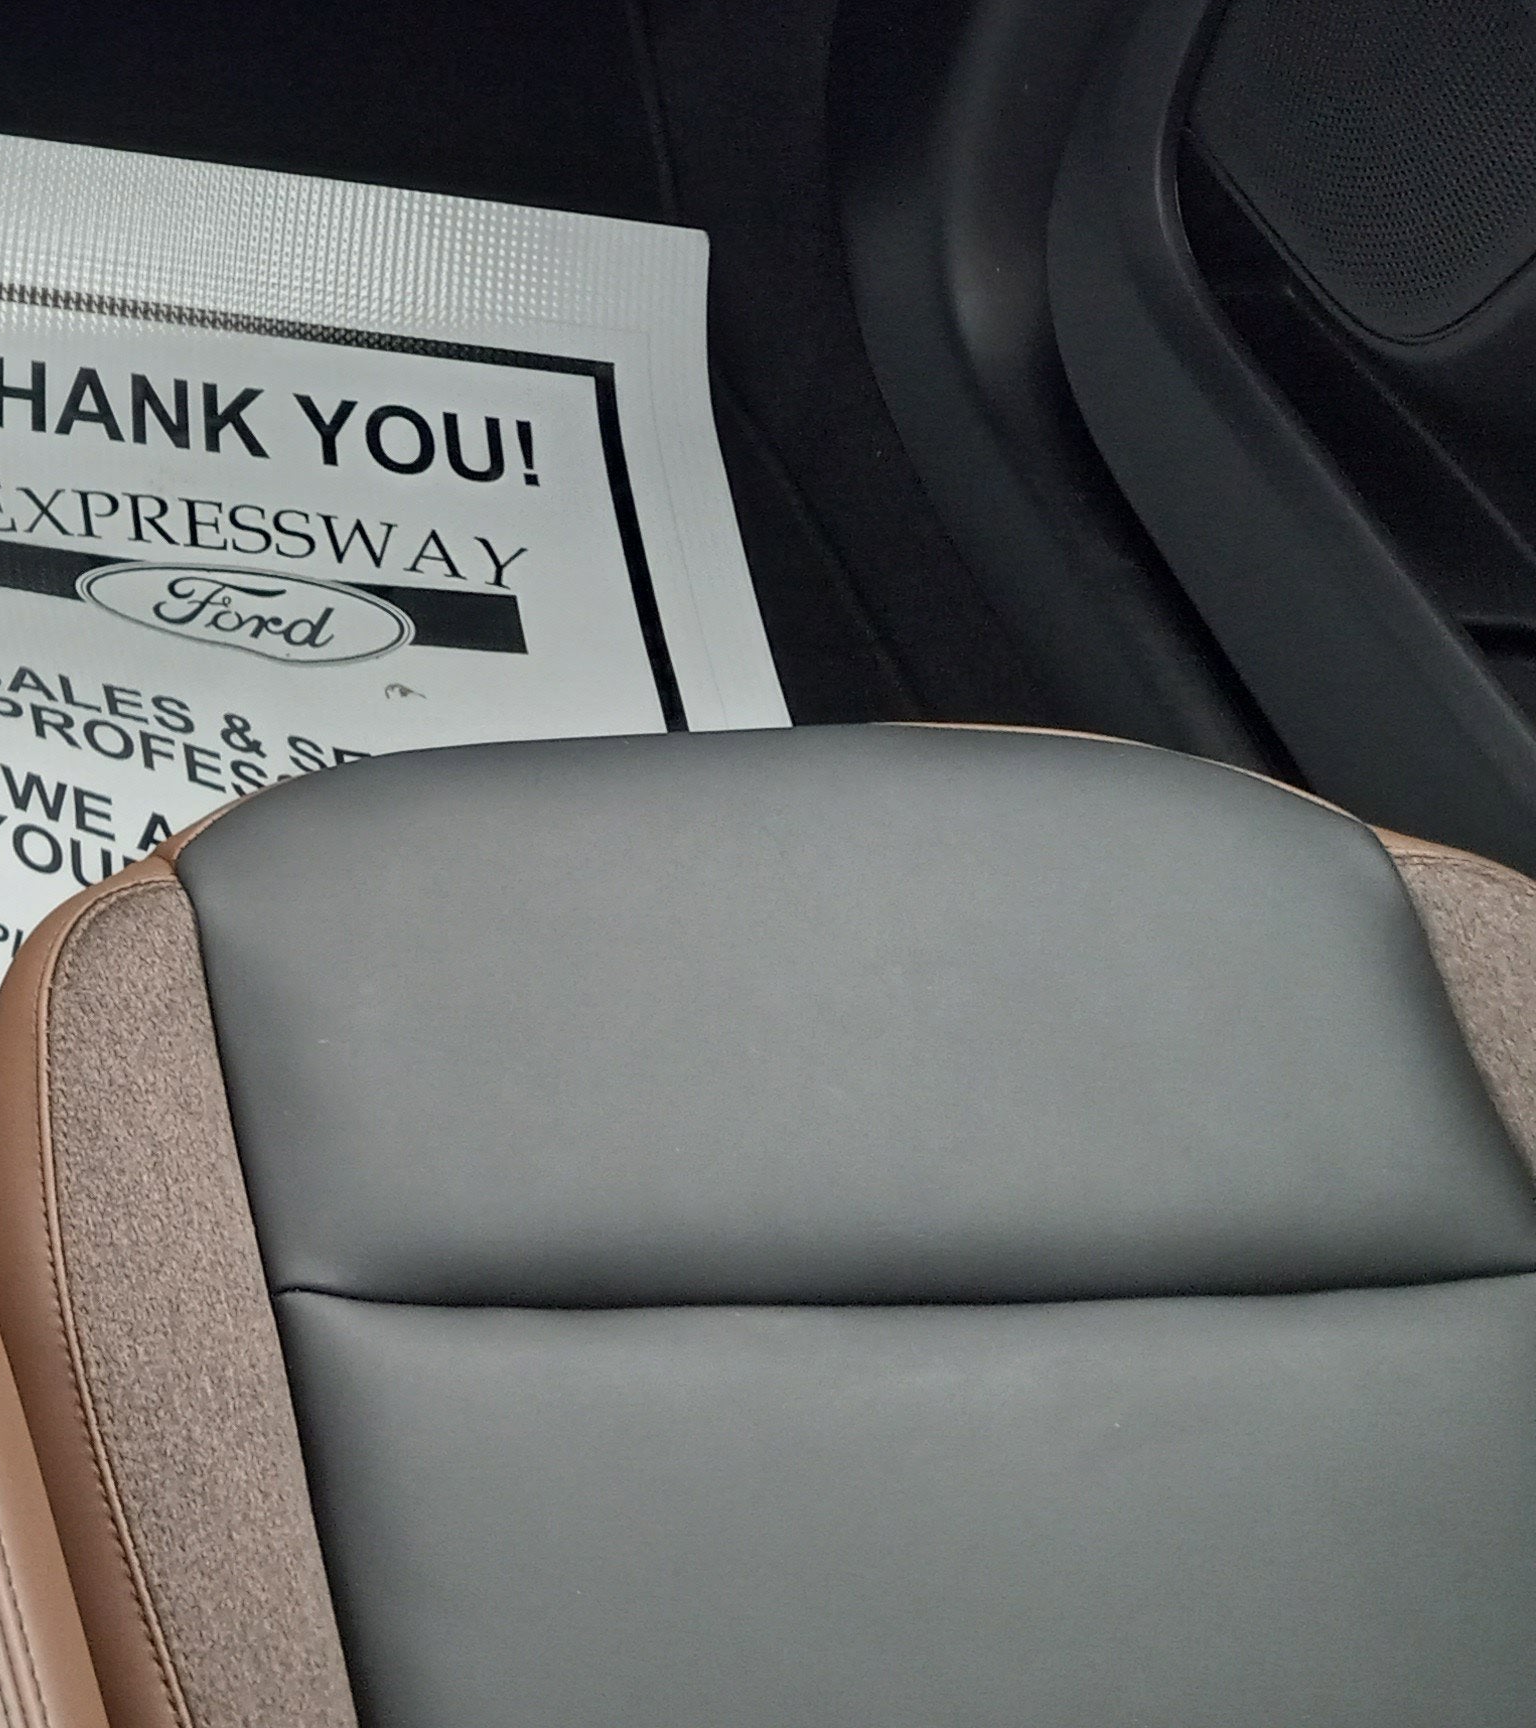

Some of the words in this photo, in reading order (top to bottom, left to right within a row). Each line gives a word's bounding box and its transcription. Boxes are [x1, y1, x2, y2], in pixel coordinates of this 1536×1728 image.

[293, 393, 541, 488] YOU!
[153, 576, 335, 650] Ford
[221, 712, 267, 758] &
[0, 763, 115, 841] WE
